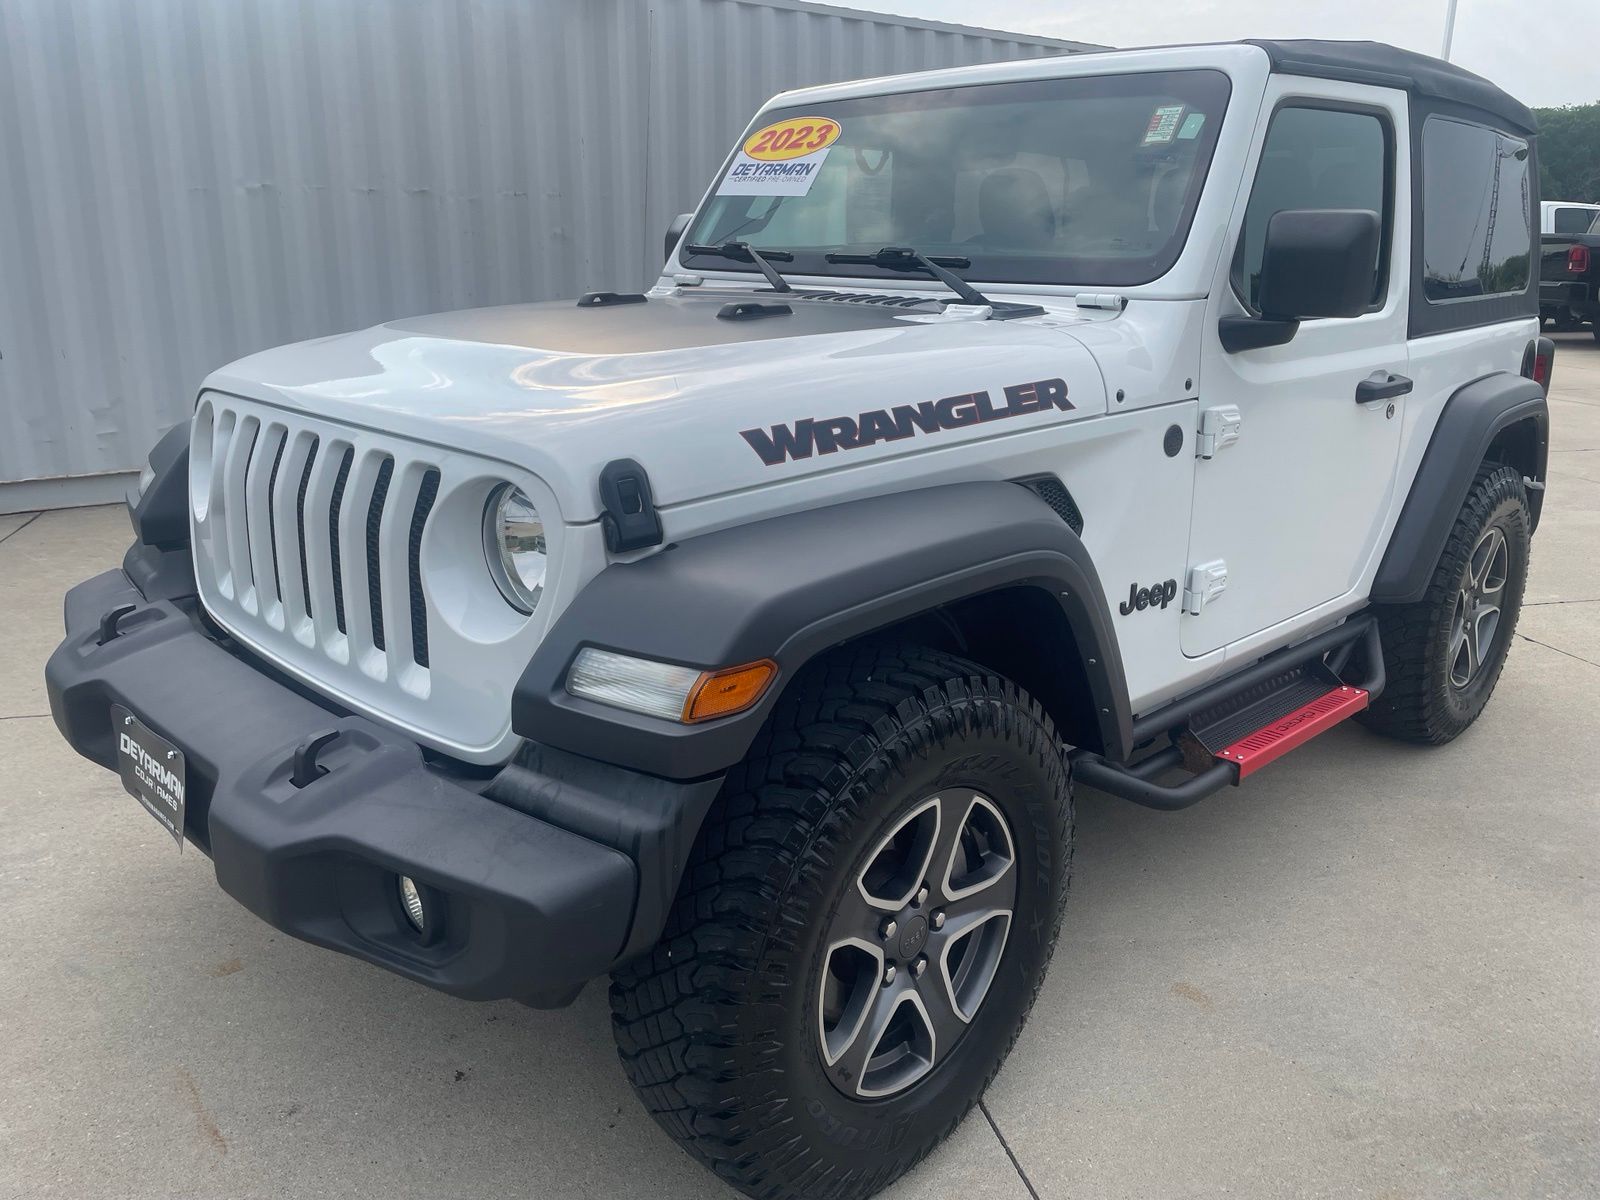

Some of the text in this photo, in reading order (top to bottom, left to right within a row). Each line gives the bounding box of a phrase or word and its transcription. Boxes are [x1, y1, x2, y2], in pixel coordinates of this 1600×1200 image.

[751, 124, 834, 154] 2023
[732, 162, 817, 176] DEYARMAN
[738, 377, 1077, 467] WRANGLER
[1119, 578, 1178, 617] Jeep
[120, 732, 185, 805] DEYARMAN
[156, 785, 178, 812] AMES
